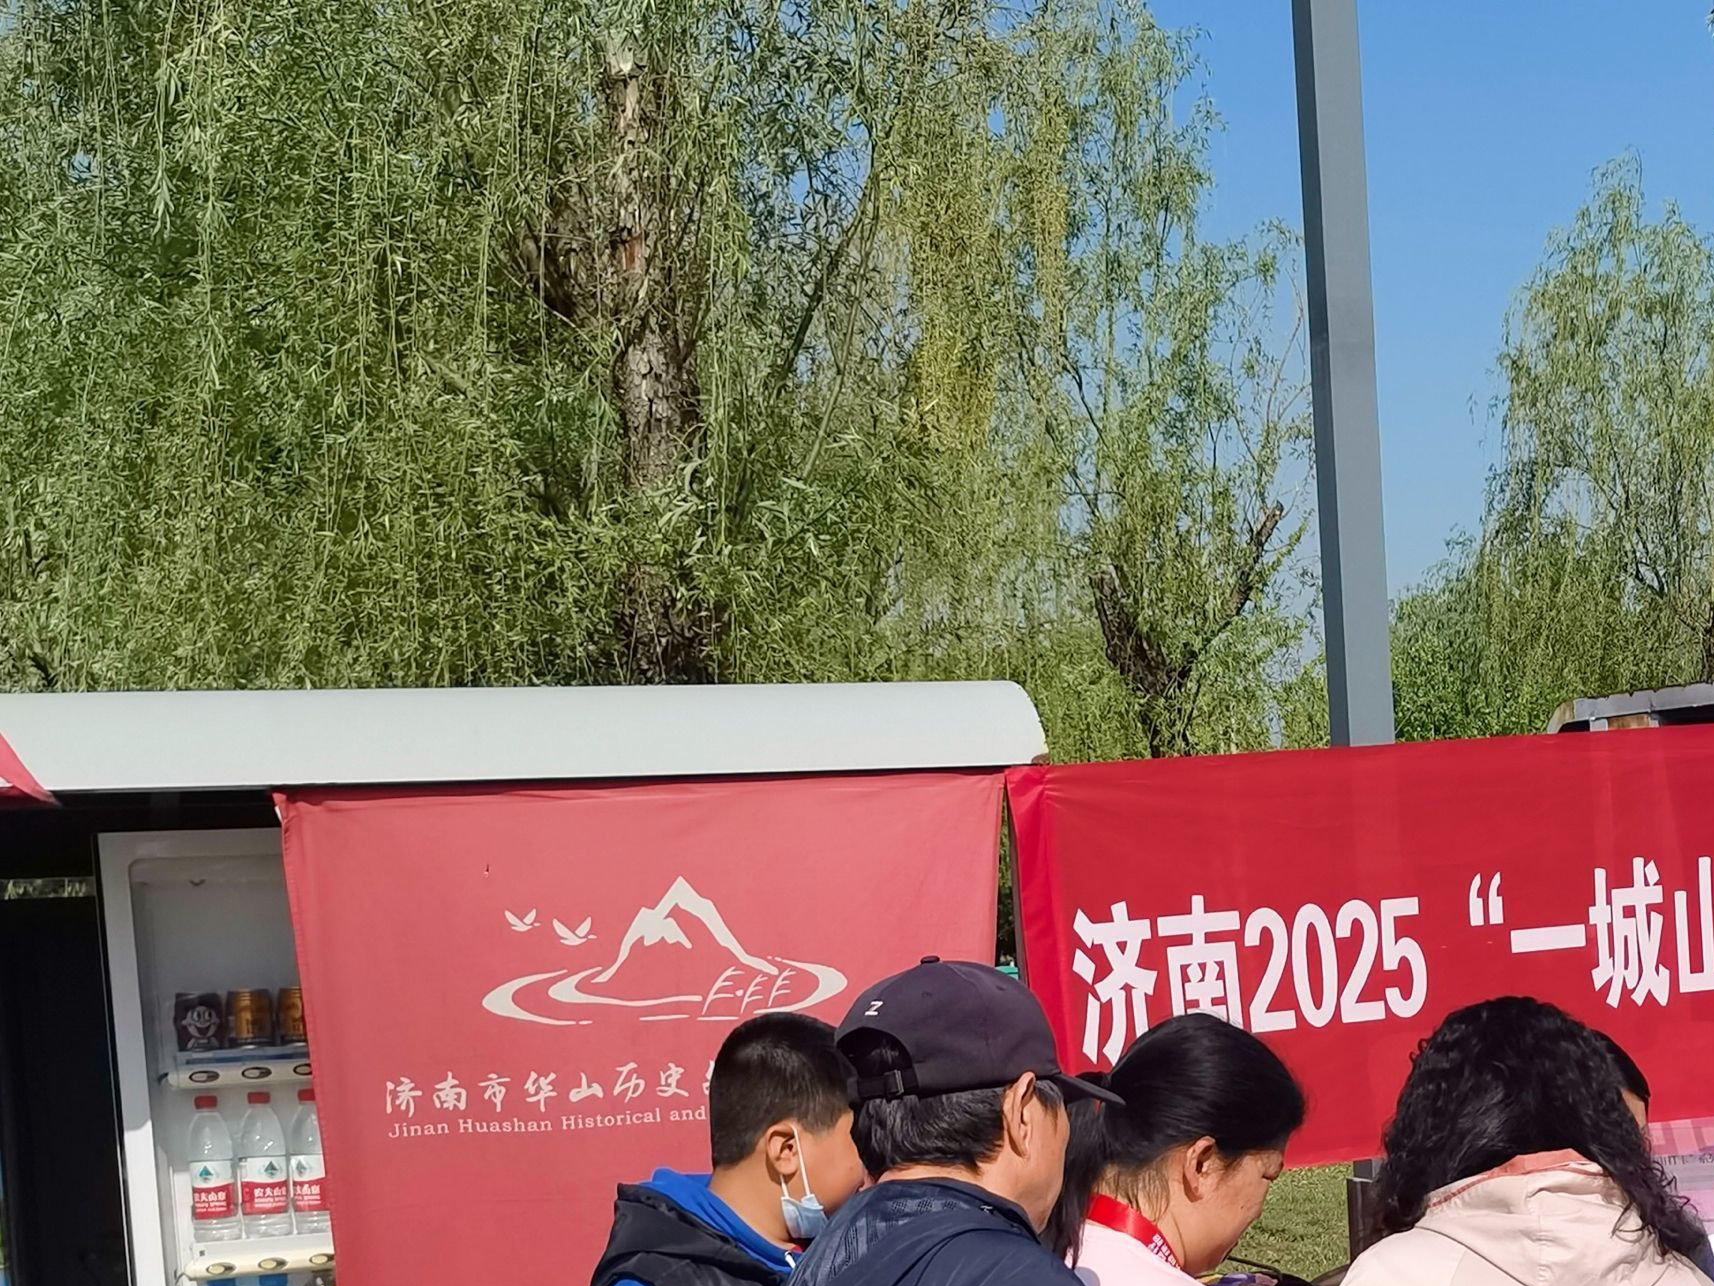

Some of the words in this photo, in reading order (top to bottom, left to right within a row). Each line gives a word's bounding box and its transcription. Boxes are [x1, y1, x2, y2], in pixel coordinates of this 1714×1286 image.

[388, 1121, 449, 1138] Jinan
[458, 1117, 553, 1134] Huashan
[561, 1107, 662, 1130] Historical
[669, 1105, 707, 1122] and
